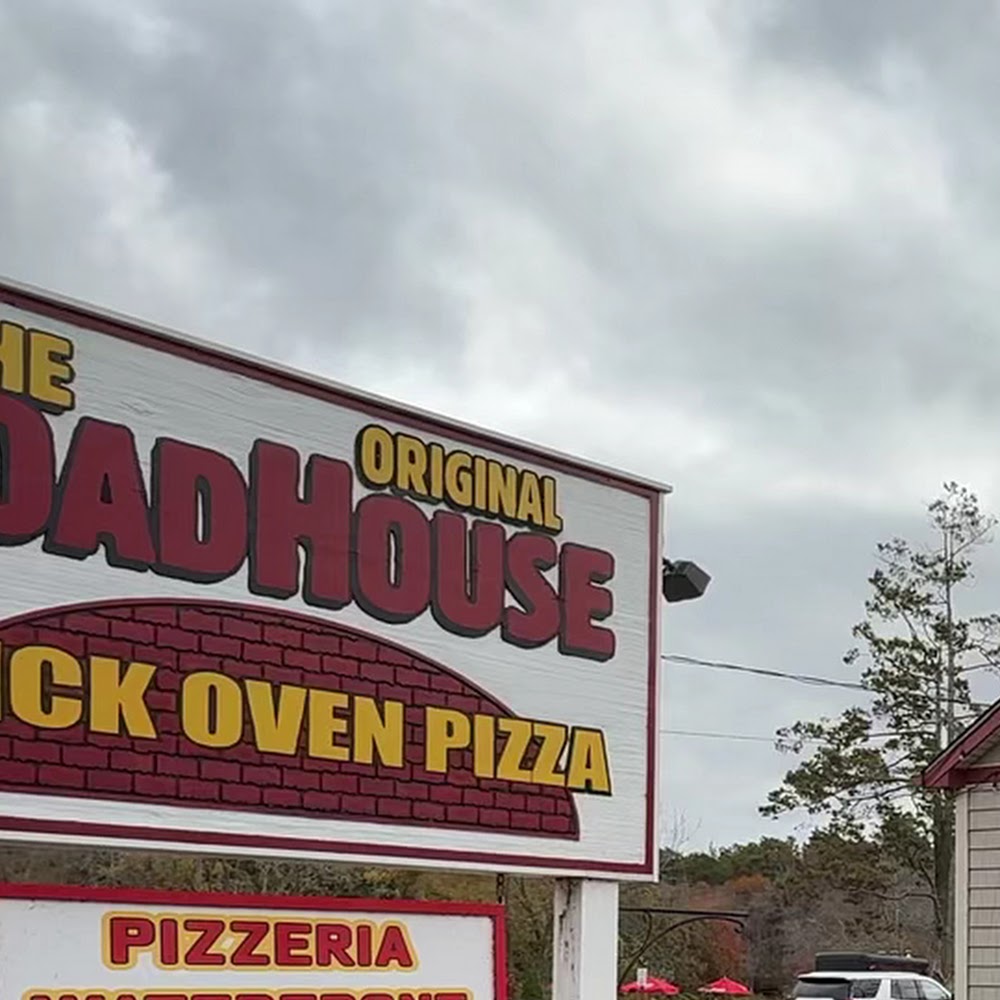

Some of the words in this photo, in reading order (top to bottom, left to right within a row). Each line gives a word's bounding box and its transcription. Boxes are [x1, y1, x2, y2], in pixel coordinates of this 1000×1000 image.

[355, 424, 563, 536] ORIGINAL
[0, 638, 158, 740] CK
[181, 670, 405, 769] OVEN
[424, 705, 612, 796] PIZZA
[106, 914, 416, 970] PIZZERIA
